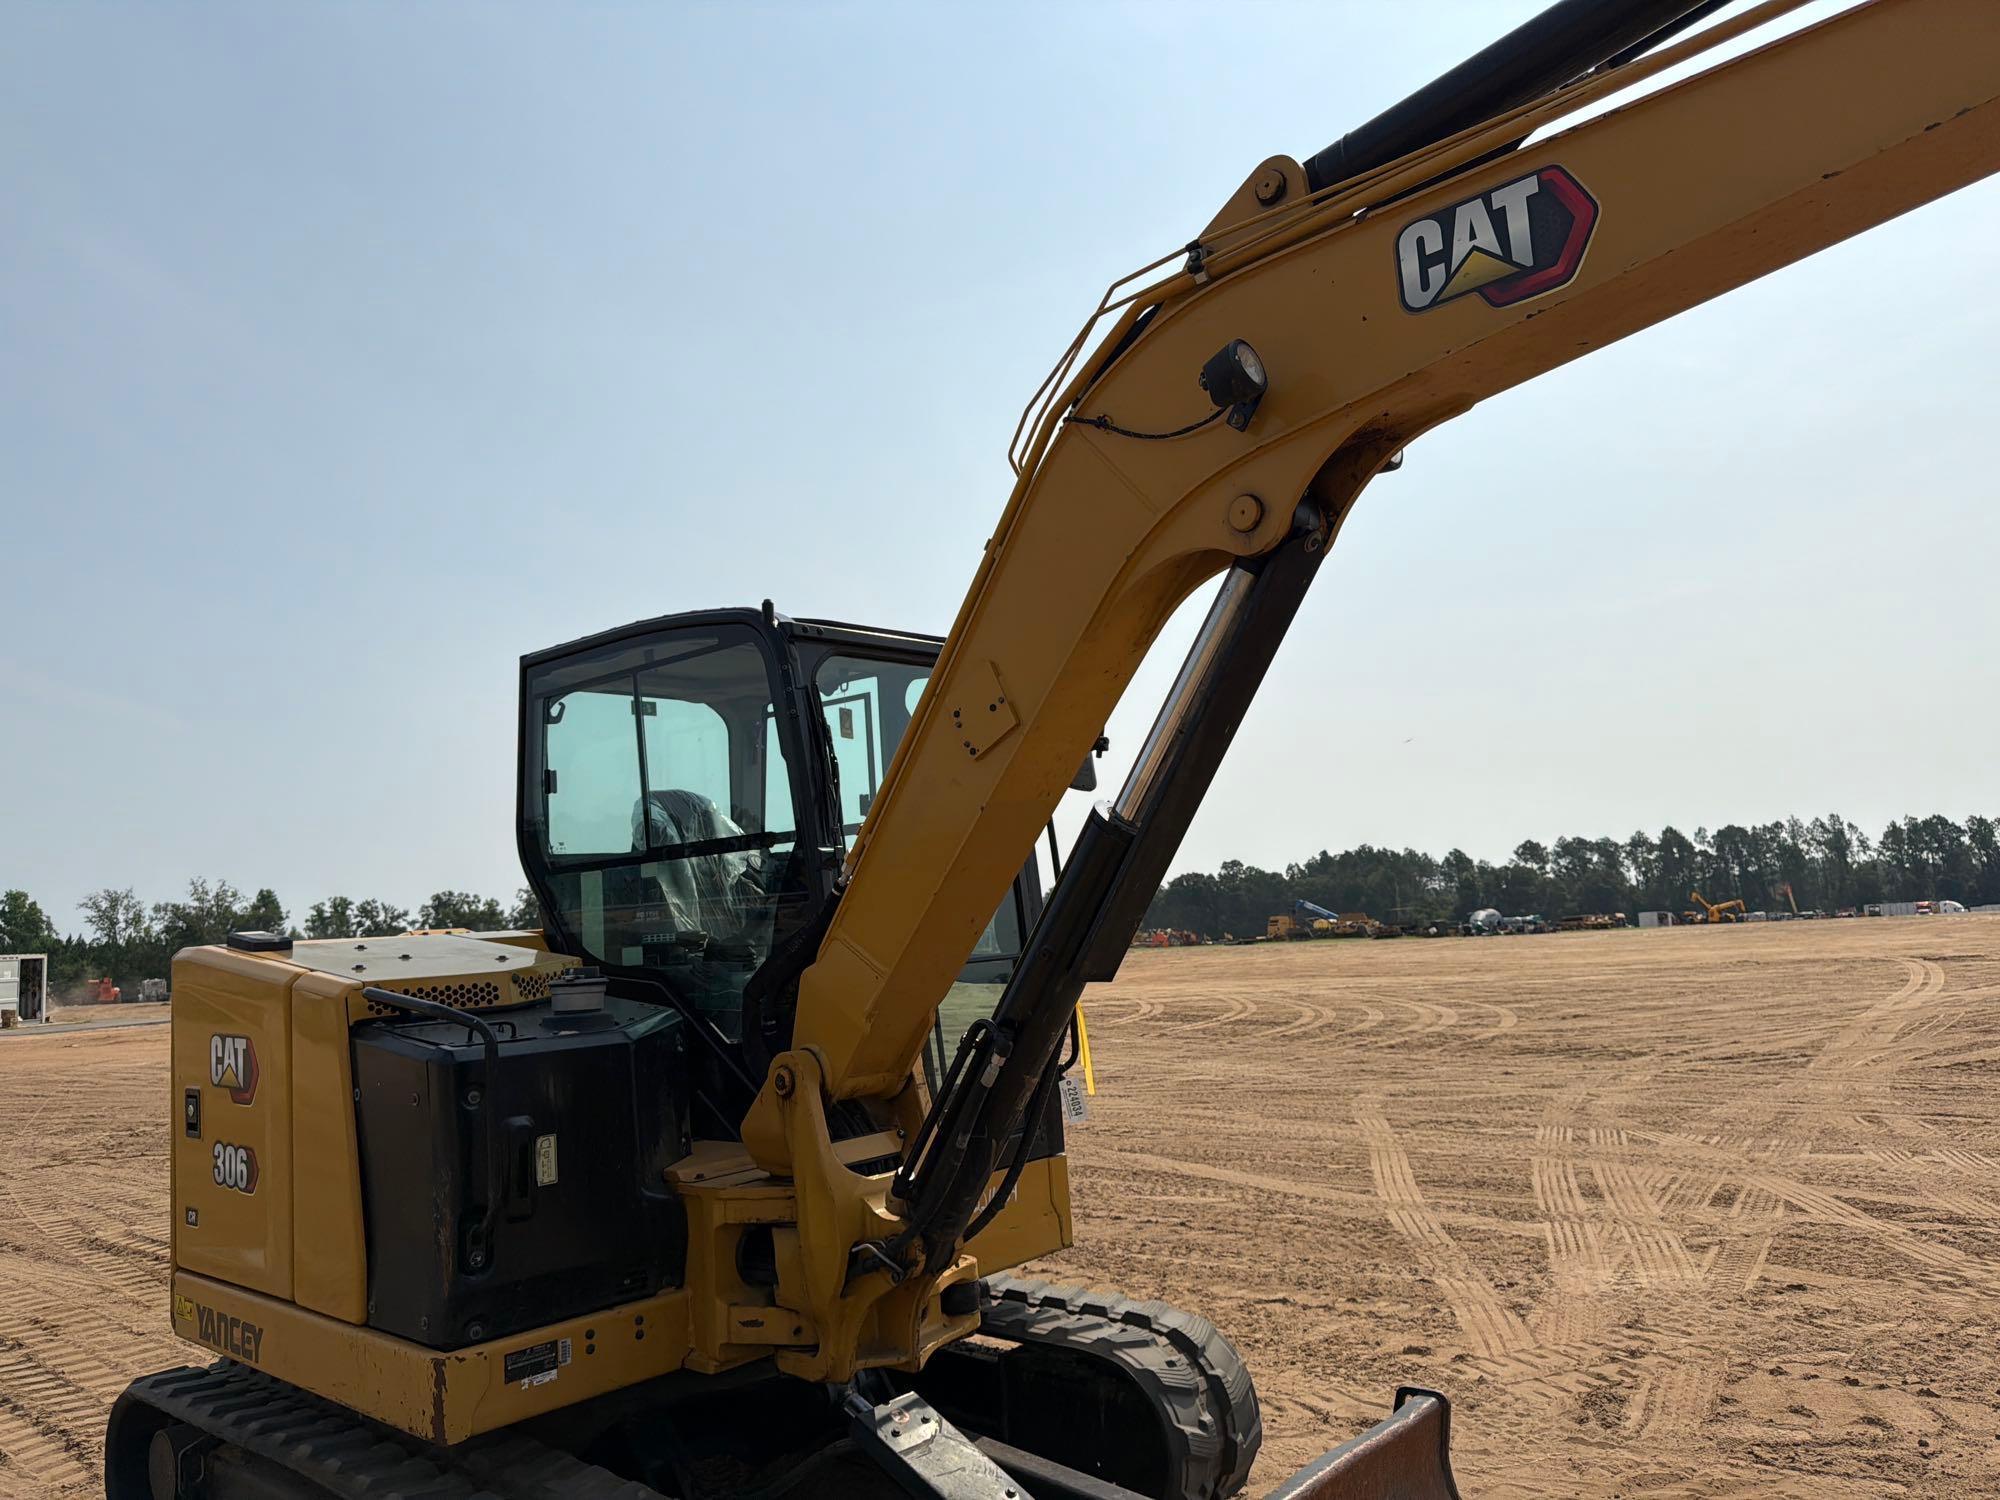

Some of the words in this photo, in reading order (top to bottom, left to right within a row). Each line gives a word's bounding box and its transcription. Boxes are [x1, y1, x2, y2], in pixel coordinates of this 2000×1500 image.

[1399, 174, 1539, 308] CAT
[211, 1035, 247, 1088] CAT
[1067, 1086, 1083, 1117] 224034
[214, 1143, 248, 1189] 306
[188, 1210, 196, 1224] CR
[196, 1303, 264, 1364] YANCEY
